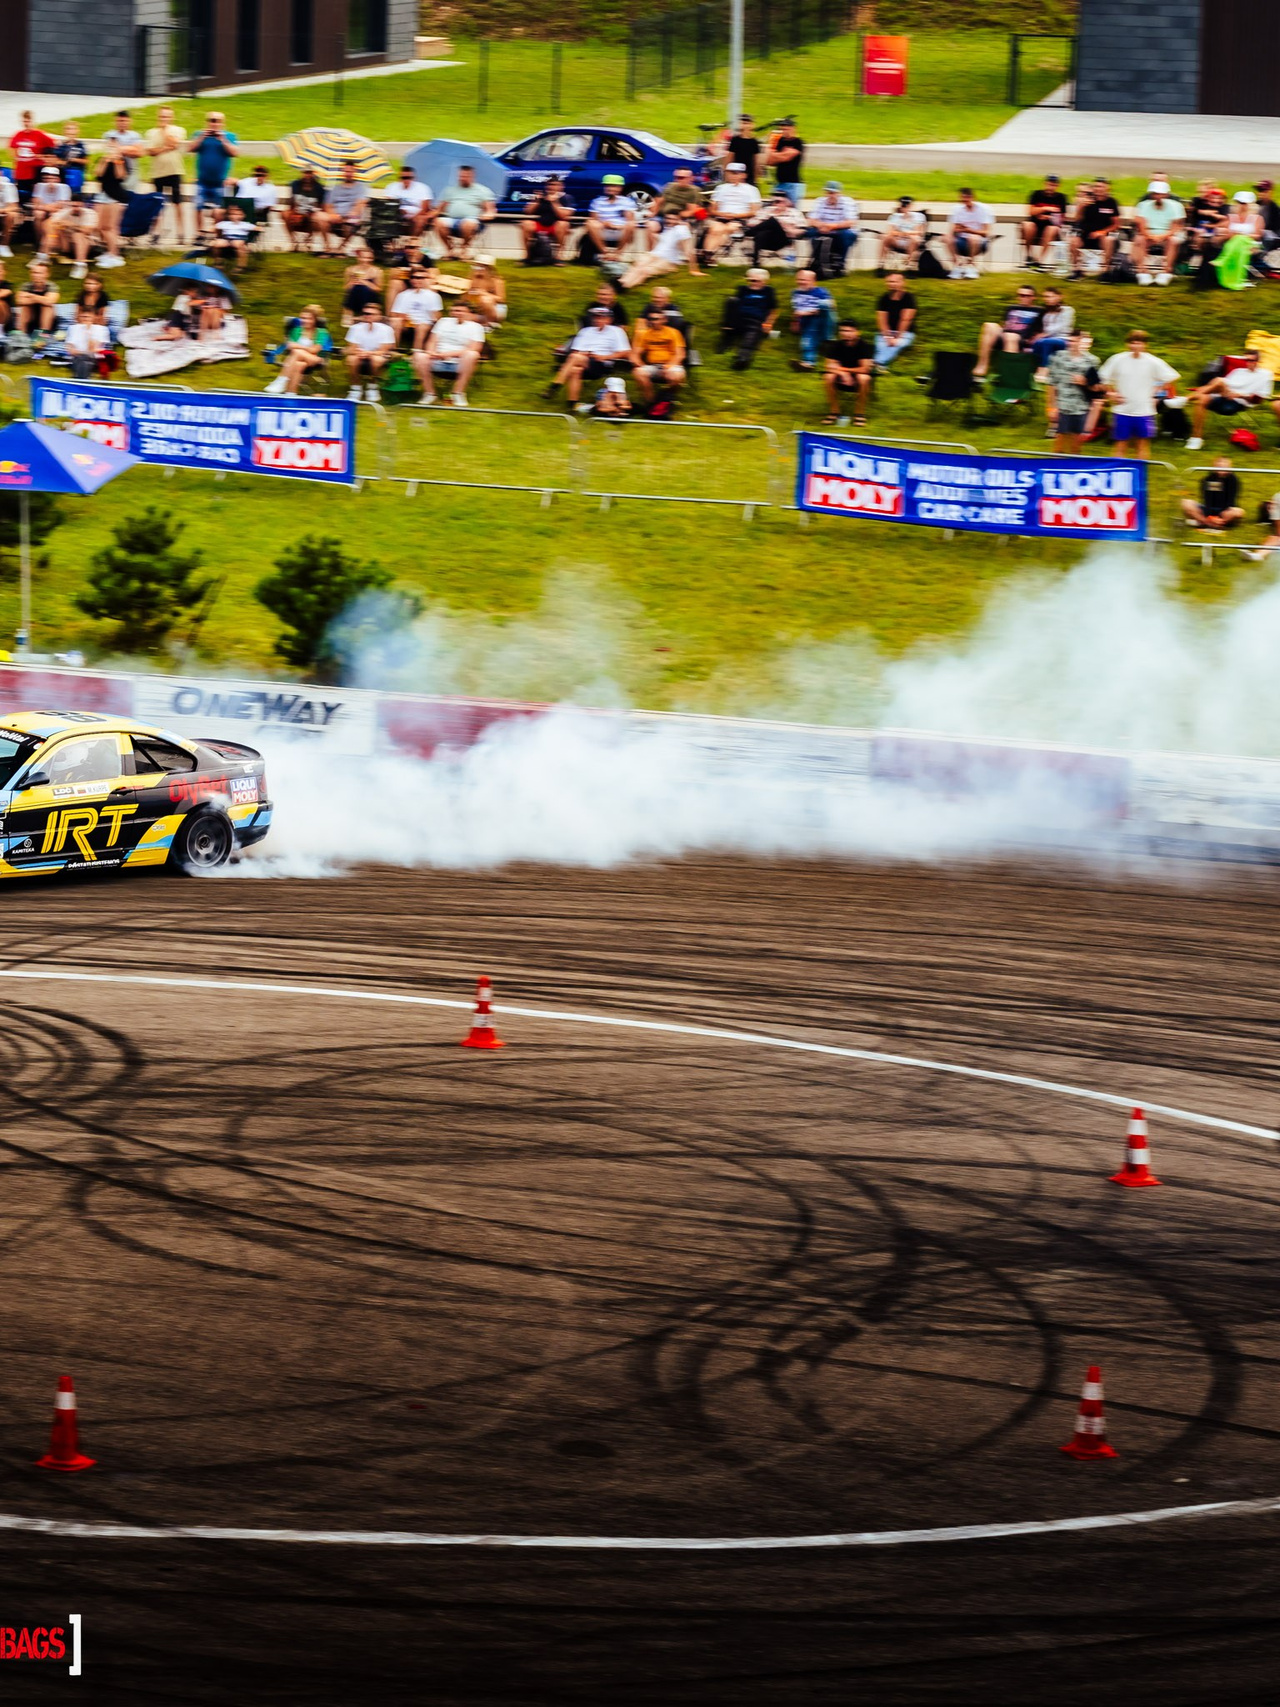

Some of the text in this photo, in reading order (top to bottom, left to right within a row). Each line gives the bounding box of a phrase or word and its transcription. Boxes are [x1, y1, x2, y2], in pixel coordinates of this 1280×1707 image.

[811, 447, 900, 484] LIQUI
[807, 476, 902, 515] MOLY
[1042, 472, 1134, 496] LIQUI
[1041, 499, 1137, 528] MOLY
[231, 779, 256, 791] LIQUI
[233, 791, 258, 802] MOLY
[41, 804, 139, 861] IRT
